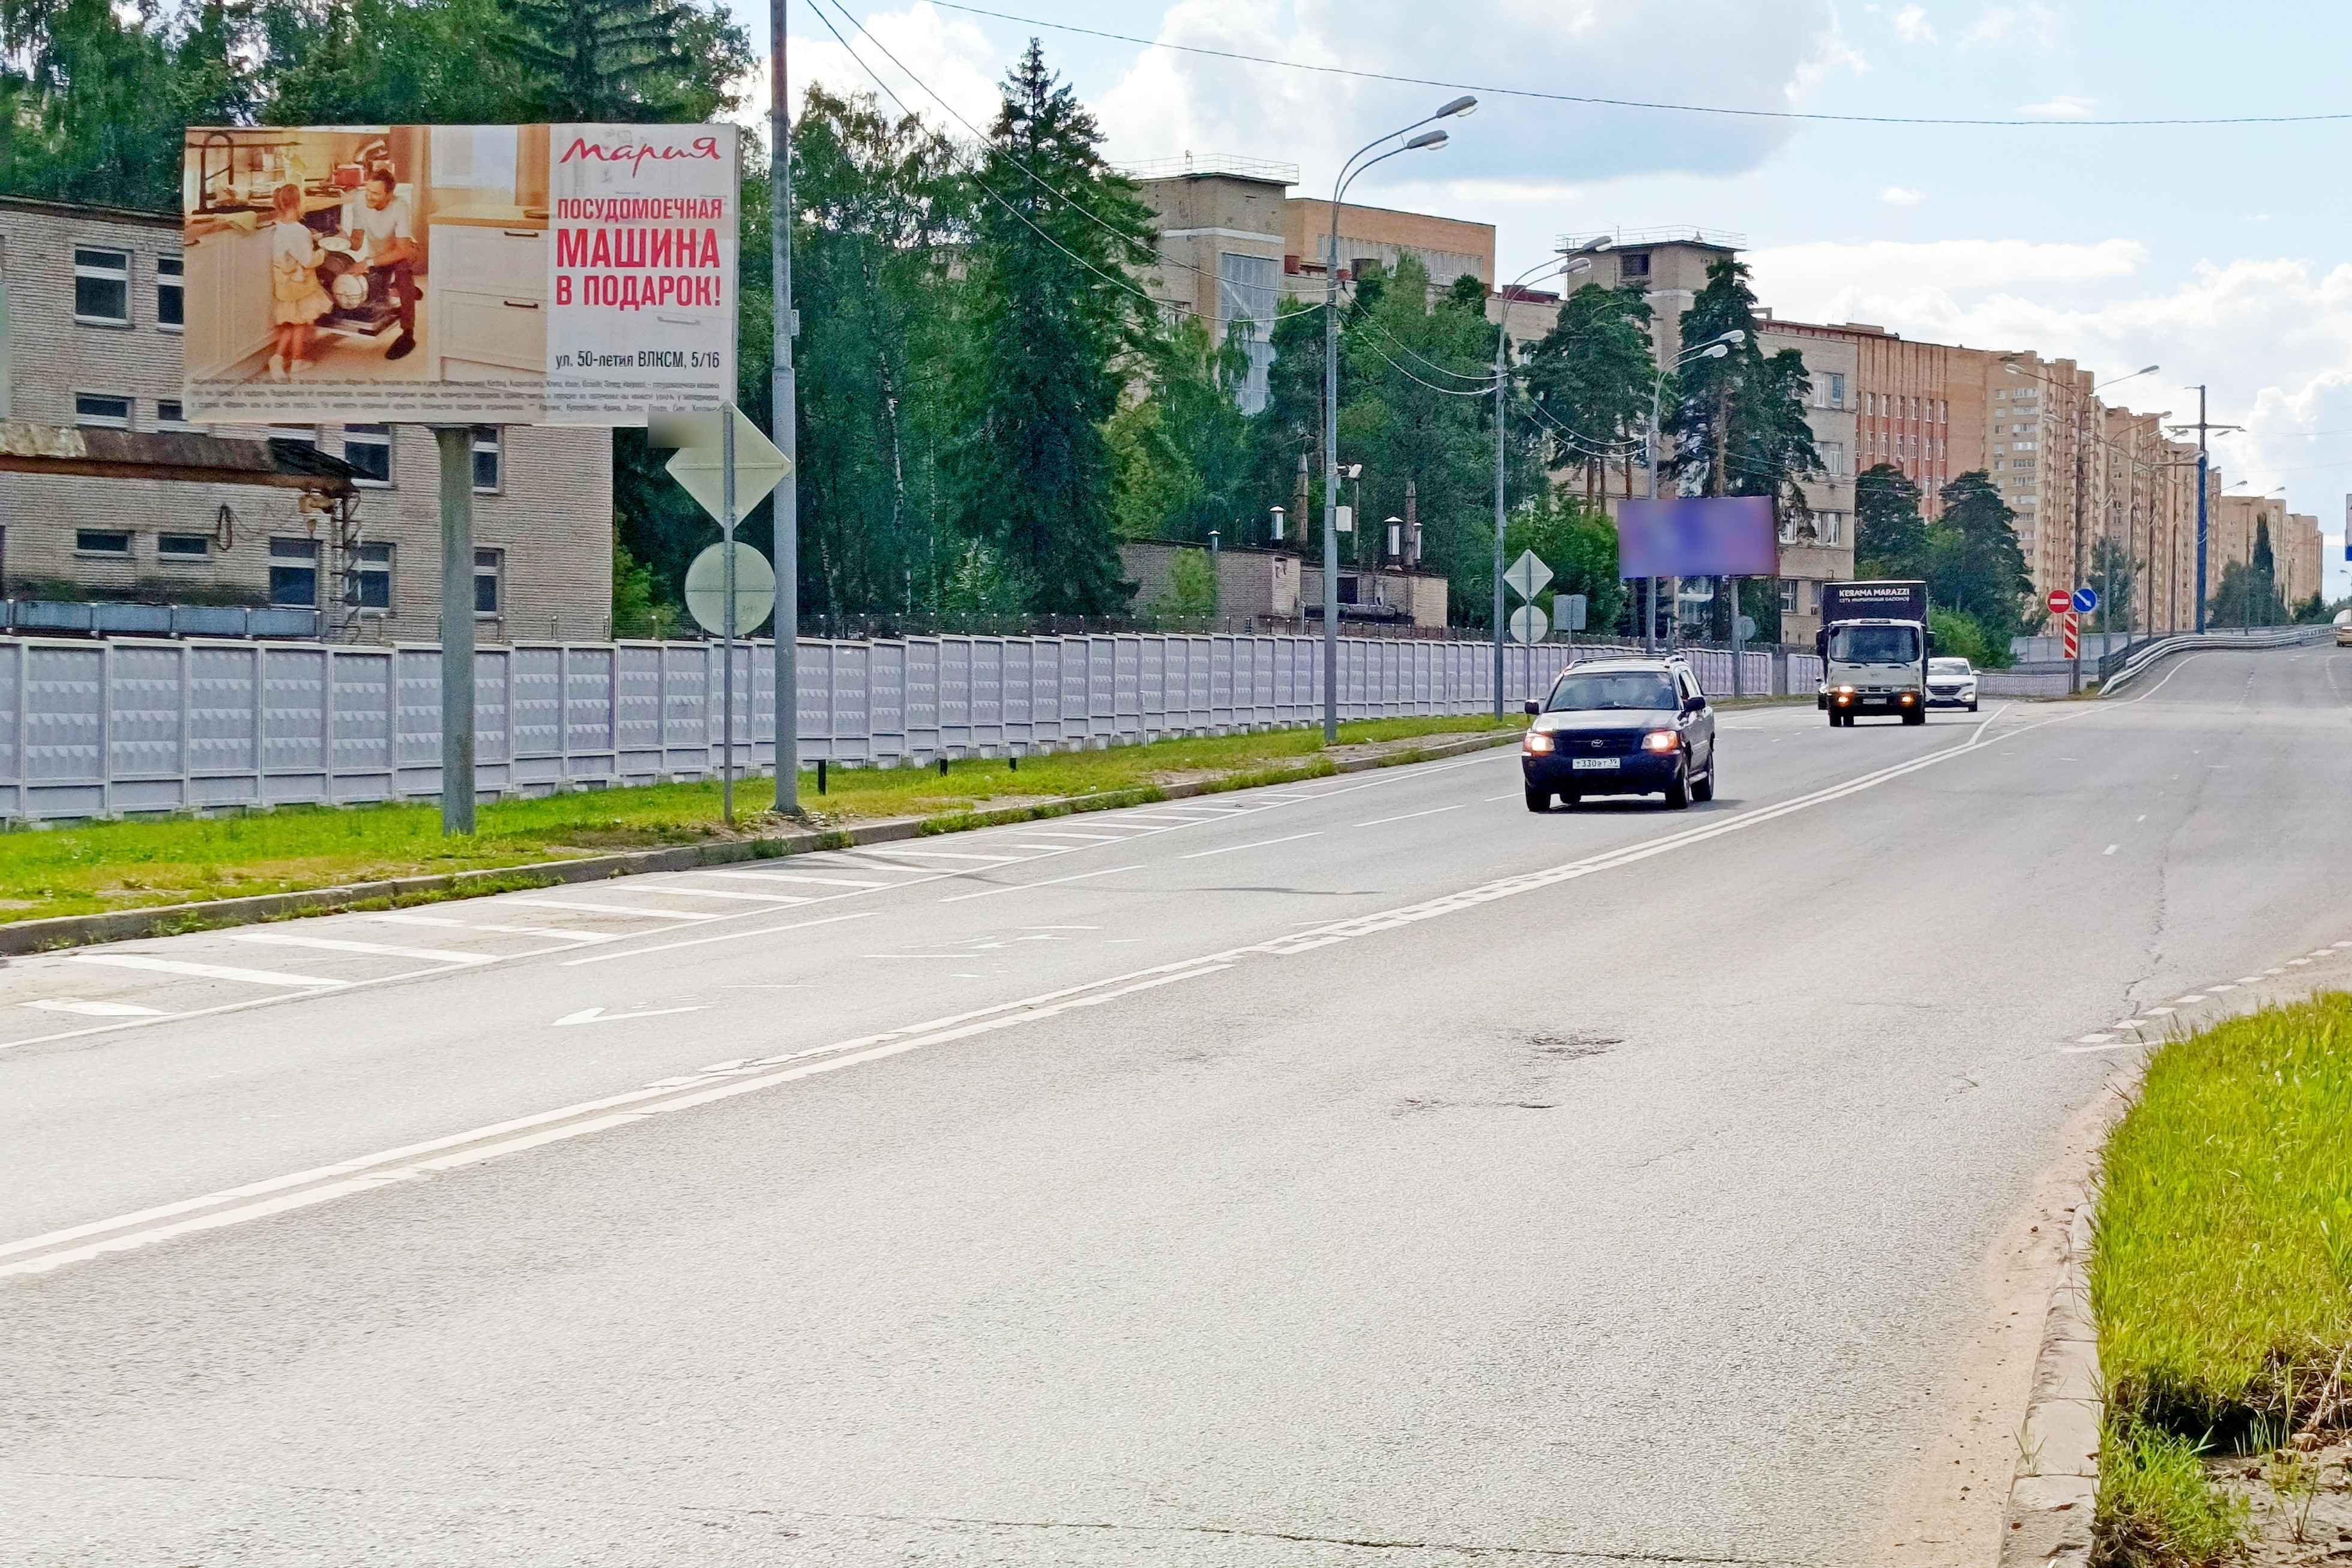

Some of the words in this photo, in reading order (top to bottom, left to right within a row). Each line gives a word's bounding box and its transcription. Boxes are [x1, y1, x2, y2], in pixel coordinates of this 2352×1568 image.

[558, 199, 722, 223] ПОСУДОМОЕЧНАЯ
[557, 229, 720, 268] МАШИНА
[556, 276, 571, 305] В
[584, 276, 720, 311] ПОДАРОК!
[555, 355, 573, 369] ул.
[577, 351, 633, 367] 50-летия
[638, 351, 686, 368] ВЛКСМ,
[691, 352, 719, 367] 5/16
